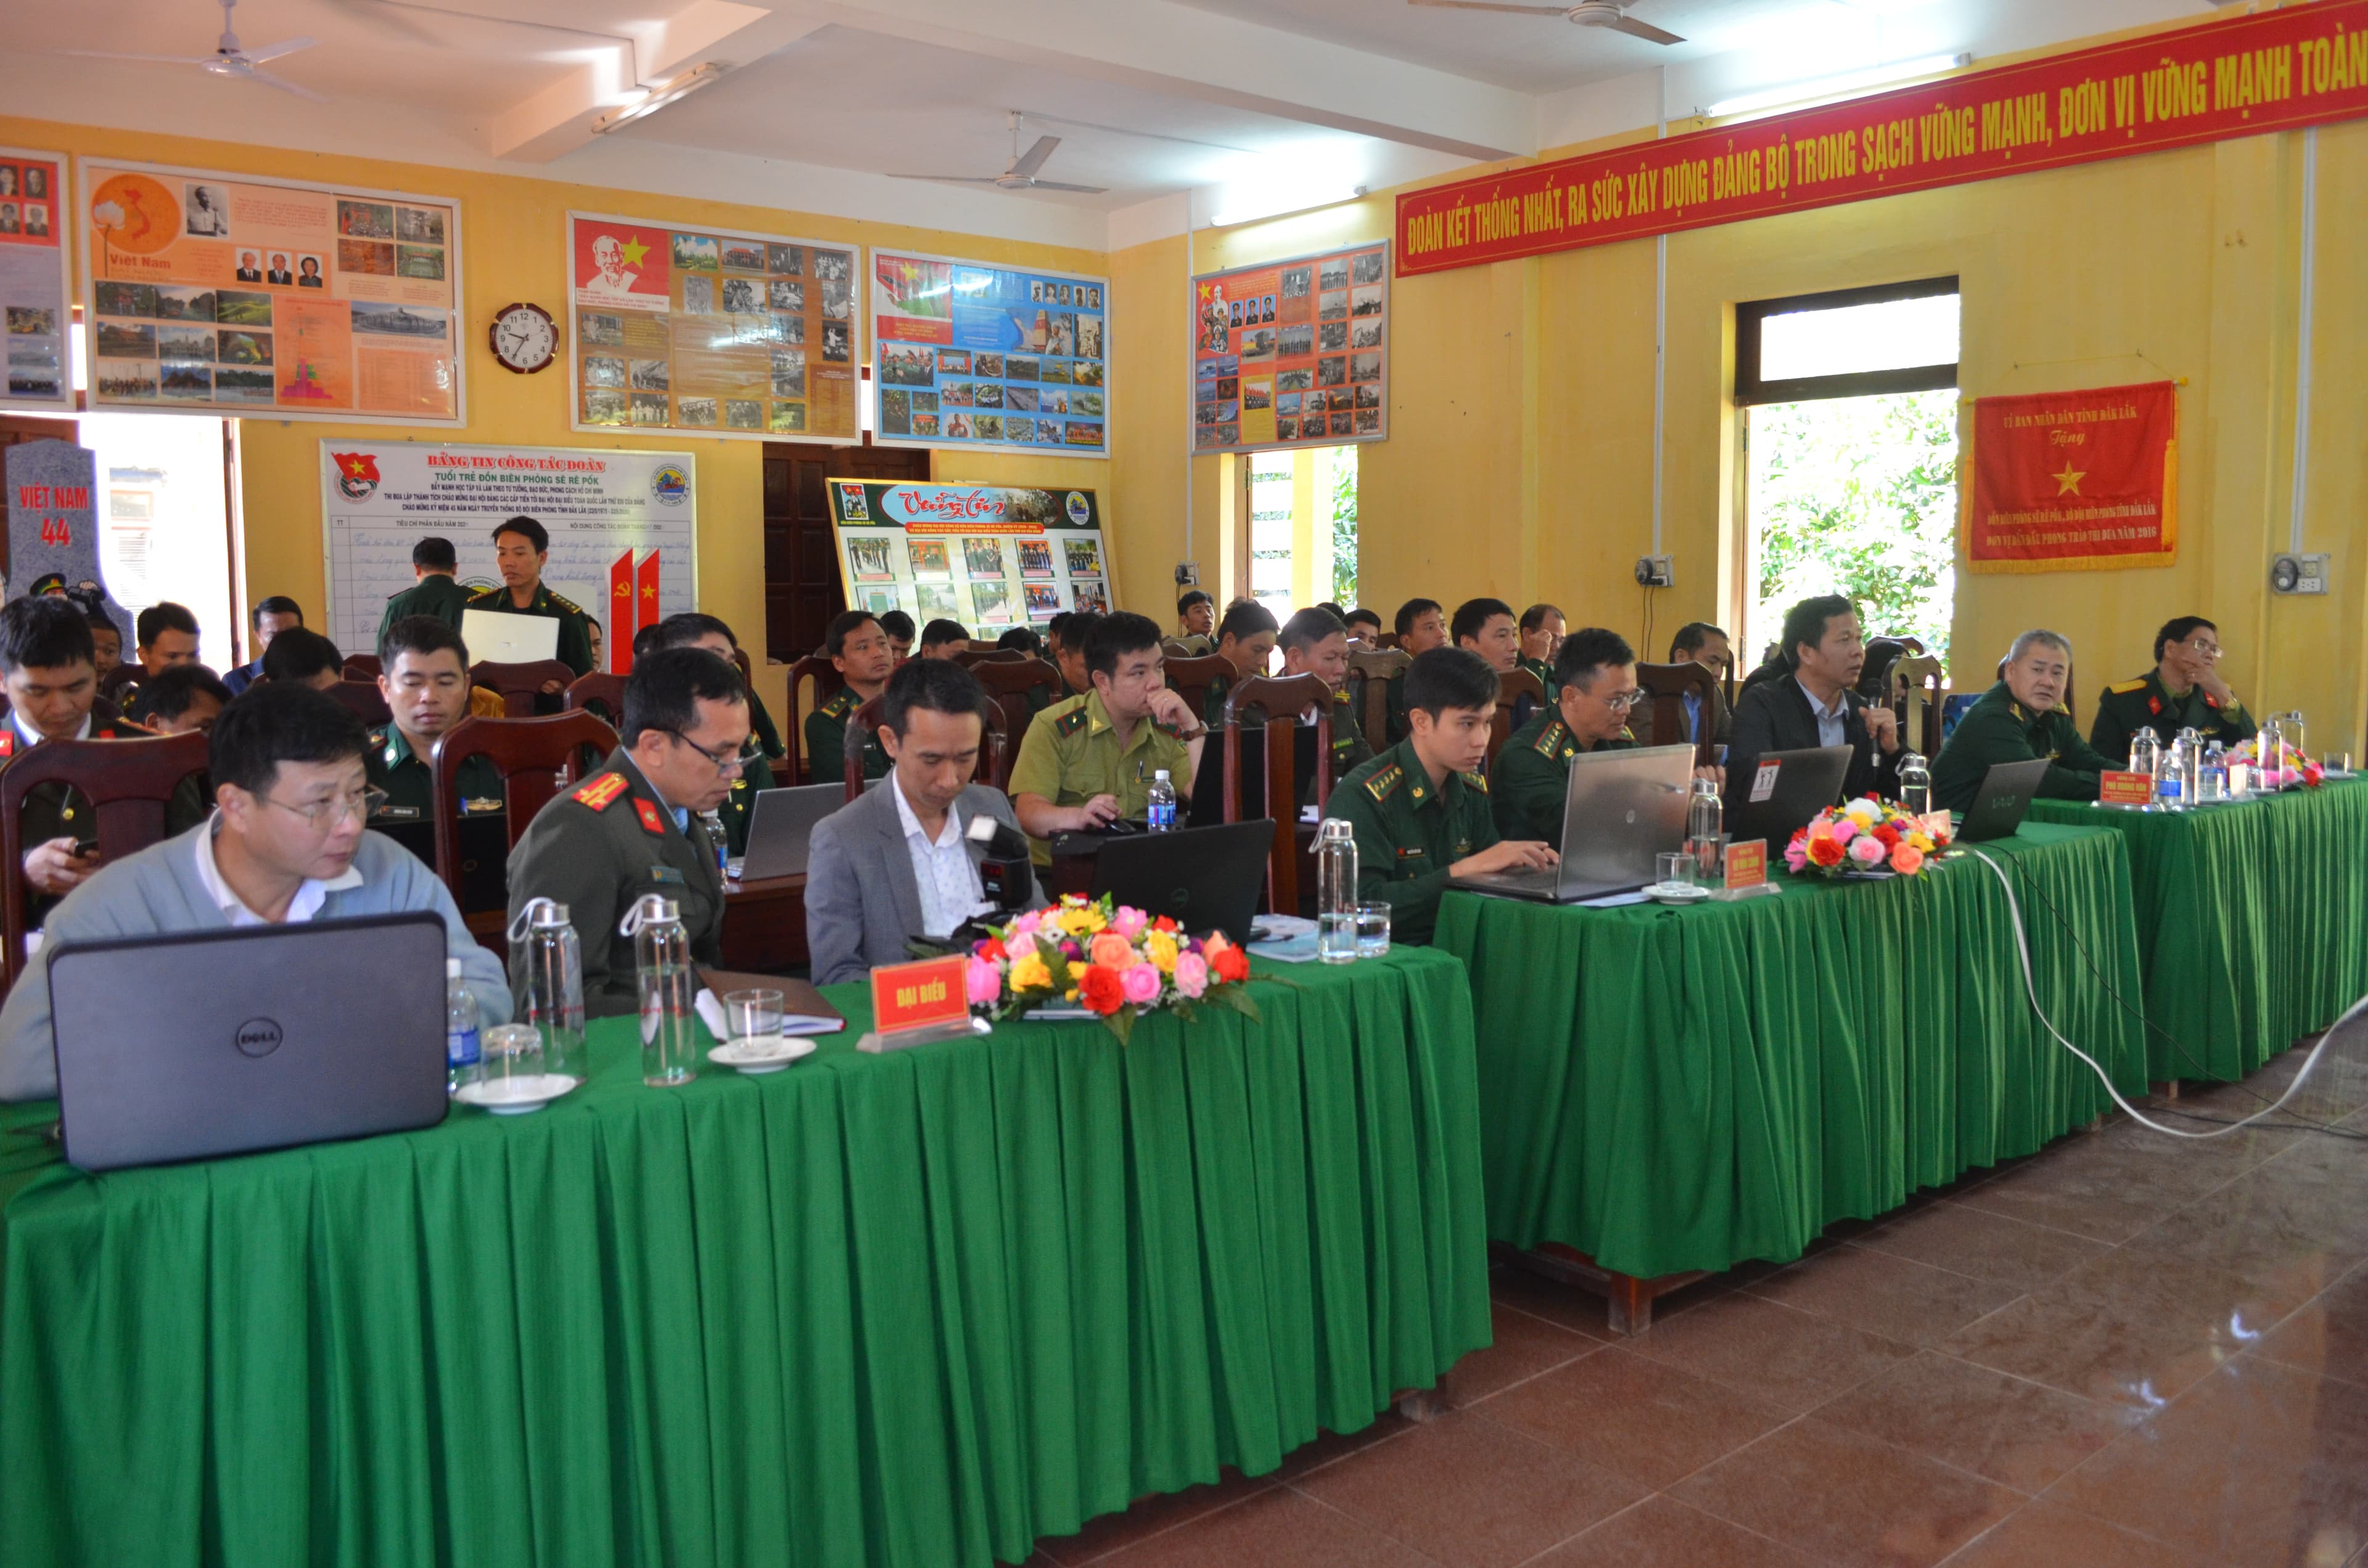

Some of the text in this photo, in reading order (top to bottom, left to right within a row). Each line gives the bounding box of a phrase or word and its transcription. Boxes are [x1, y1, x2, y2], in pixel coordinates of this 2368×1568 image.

[1408, 22, 2368, 255] ĐOÀN KẾT THỐNG NHẤT, RA SỨC XÂY DỰNG ĐẢNG BỘ TRONG SẠCH VỮNG MẠNH, ĐƠN VỊ VỮNG MẠNH TOÀN
[142, 257, 171, 269] Nam
[520, 313, 528, 321] 12
[544, 335, 549, 343] 3
[504, 345, 509, 353] 8
[540, 345, 545, 353] 4
[2015, 416, 2032, 427] BAN
[2034, 411, 2055, 427] NHÂN
[2050, 430, 2086, 447] Tặng
[427, 451, 469, 467] BẢNG
[471, 457, 496, 469] TIN
[498, 454, 536, 470] CÔNG
[538, 456, 566, 471] TÁC
[435, 469, 456, 481] TUỔI
[459, 470, 476, 481] TRẺ
[500, 473, 520, 482] BIÊN
[523, 473, 553, 483] PHÒNG
[556, 475, 566, 484] SÊ
[569, 475, 580, 484] RÊ
[20, 482, 88, 514] VIỆT NAM
[41, 518, 71, 546] 44
[897, 975, 947, 1009] ĐẠI BIỂU
[241, 1031, 278, 1045] DELL
